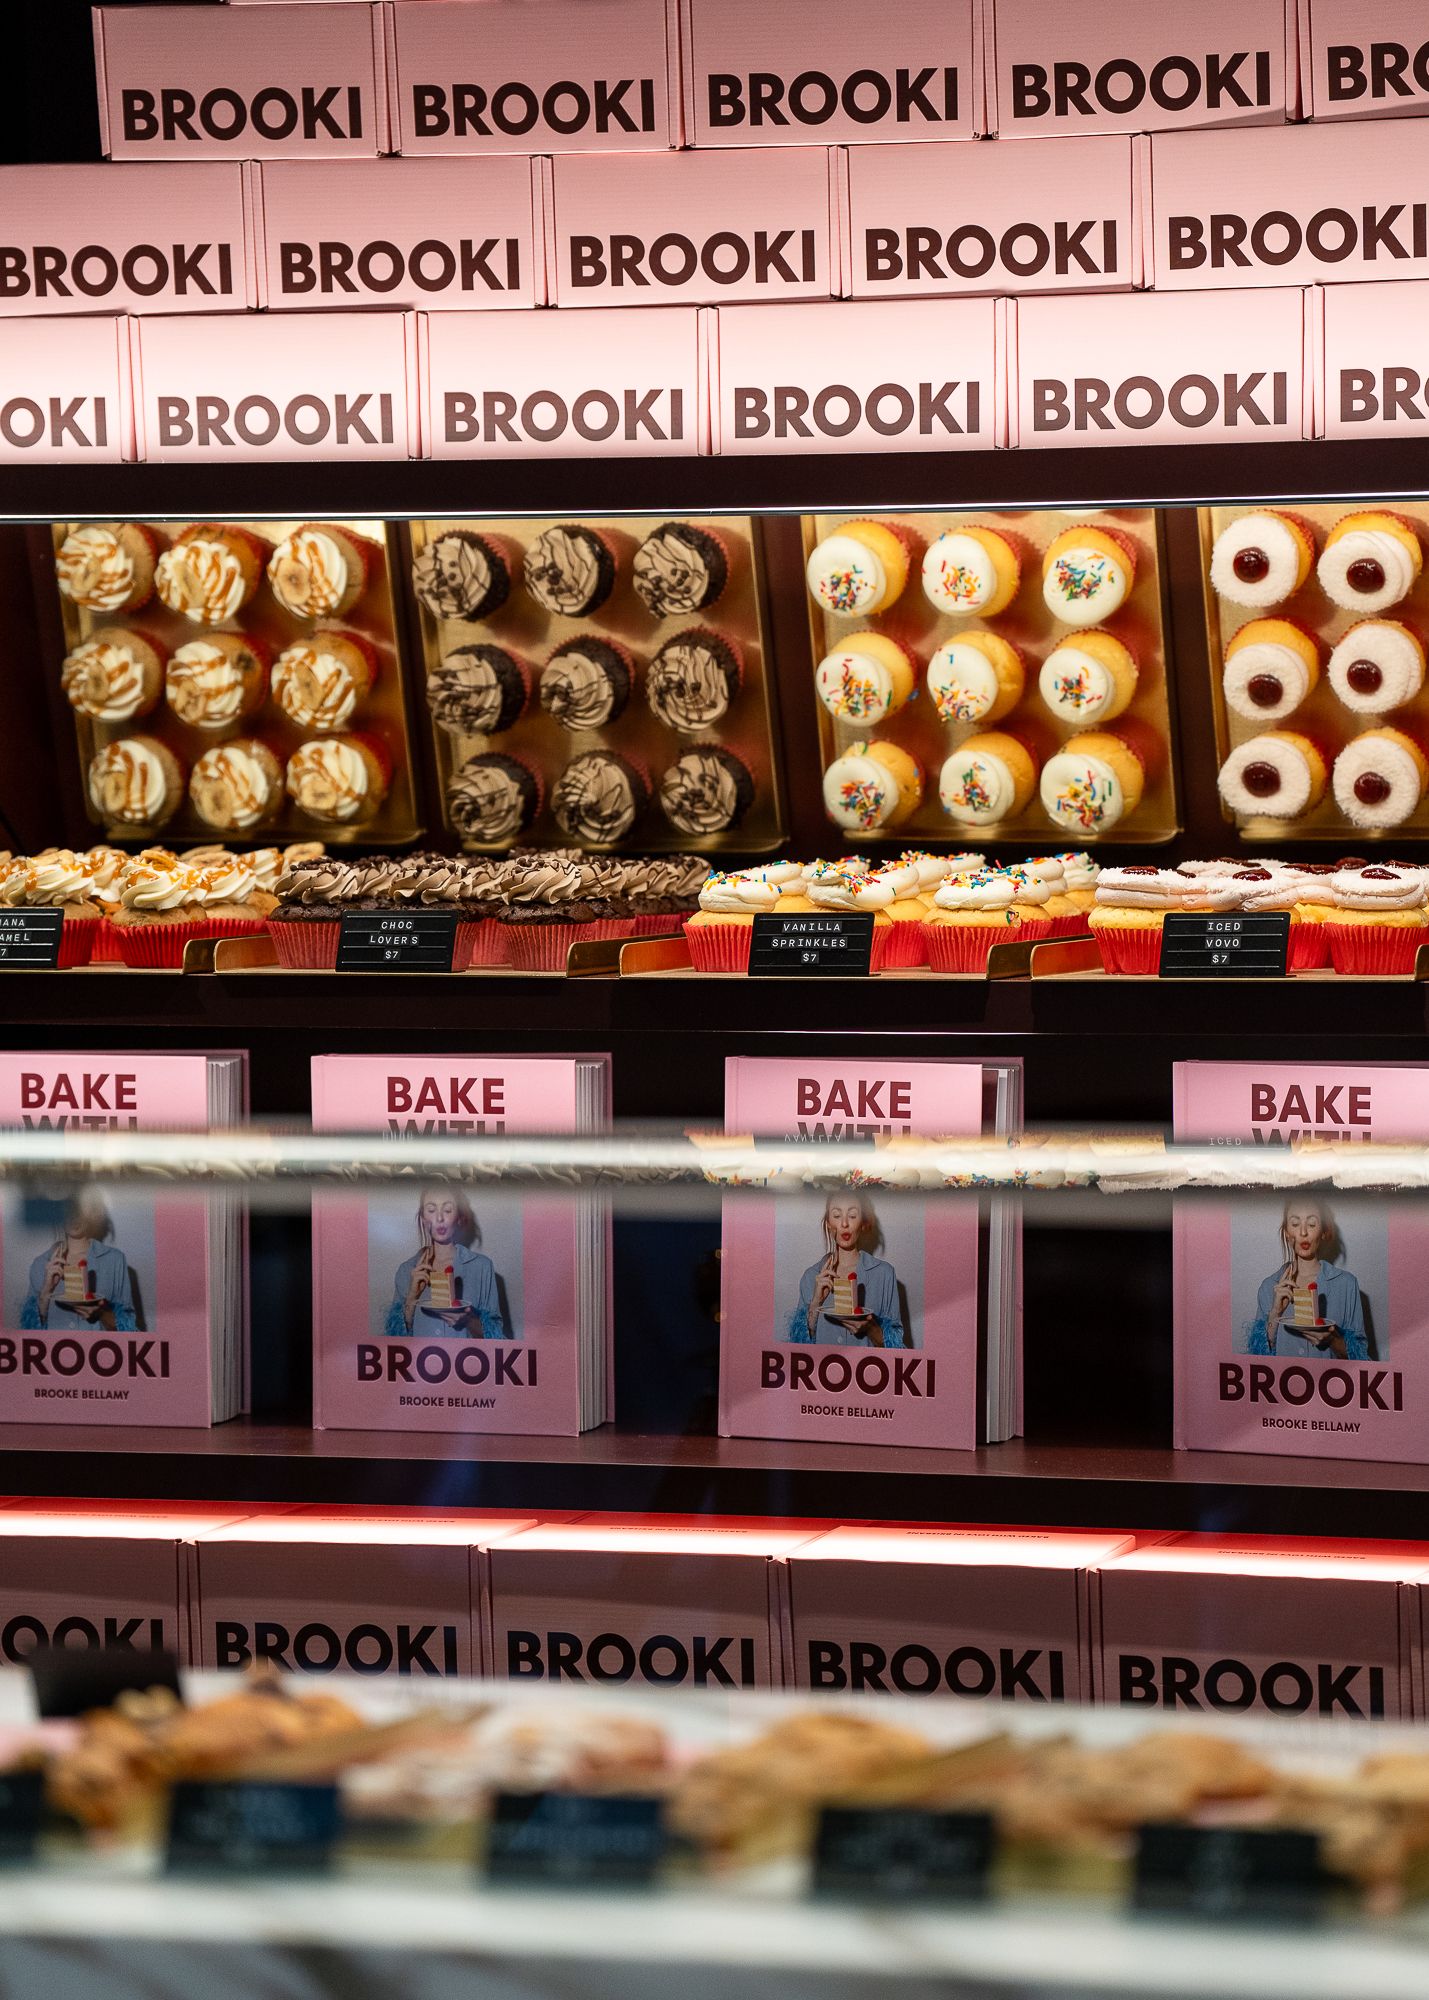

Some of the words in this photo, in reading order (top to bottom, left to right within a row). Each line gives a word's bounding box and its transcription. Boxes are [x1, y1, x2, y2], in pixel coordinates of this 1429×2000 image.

[413, 79, 655, 136] BROOKI
[708, 67, 958, 127] BROOKI
[1012, 51, 1270, 118] BROOKI
[122, 87, 362, 140] BROOKI
[570, 230, 815, 287] BROOKI
[866, 220, 1117, 281] BROOKI
[1169, 204, 1427, 270] BROOKI
[0, 245, 232, 297] BROOKI
[280, 239, 520, 293] BROOKI
[444, 389, 683, 442] BROOKI
[735, 381, 979, 438] BROOKI
[1034, 372, 1287, 431] BROOKI
[1340, 367, 1429, 422] BR
[0, 397, 107, 448] OKI
[158, 394, 393, 446] BROOKI
[0, 919, 25, 927] ANA
[370, 936, 418, 945] LOVERS
[381, 921, 413, 930] CHOC
[772, 939, 846, 947] SPRINKLES
[783, 923, 841, 931] VANILLA
[1206, 939, 1240, 948] VOVO
[1207, 922, 1241, 931] ICED
[385, 950, 399, 959] $7
[802, 953, 817, 962] $7
[1212, 954, 1228, 963] $7
[21, 1073, 137, 1110] BAKE
[387, 1077, 505, 1114] BAKE
[797, 1078, 911, 1119] BAKE
[1251, 1083, 1372, 1125] BAKE
[0, 1338, 169, 1377] BROOKI
[357, 1344, 537, 1386] BROOKI
[761, 1351, 936, 1398] BROOKI
[34, 1389, 78, 1399] BROOKE
[82, 1390, 129, 1400] BELLAMY
[400, 1396, 444, 1407] BROOKE
[448, 1398, 496, 1408] BELLAMY
[1219, 1363, 1403, 1411] BROOKI
[801, 1405, 844, 1416] BROOKE
[848, 1408, 895, 1419] BELLAMY
[1262, 1418, 1307, 1429] BROOKE
[1311, 1421, 1361, 1432] BELLAMY
[215, 1621, 458, 1677] BROOKI
[507, 1631, 755, 1690] BROOKI
[808, 1640, 1065, 1704] BROOKI
[1119, 1654, 1385, 1721] BROOKI
